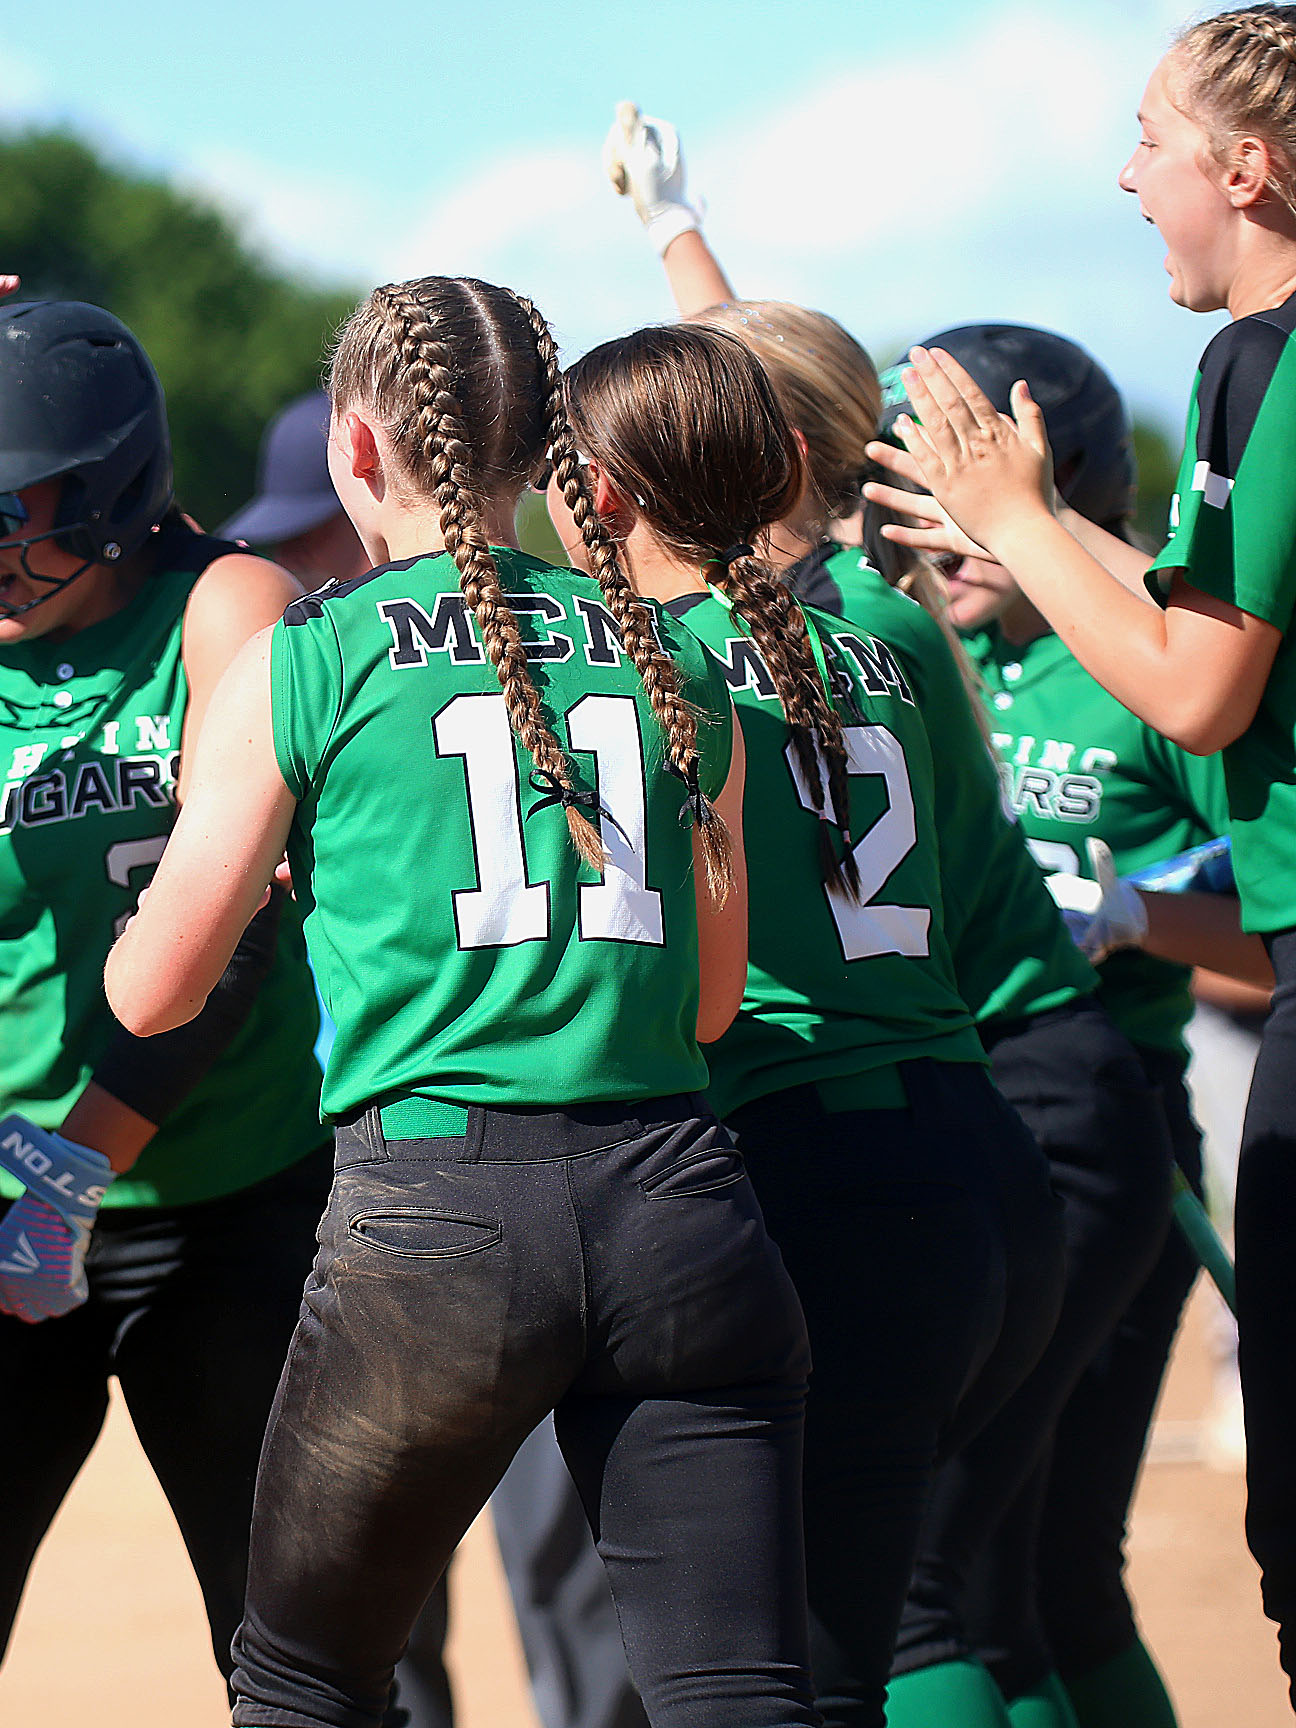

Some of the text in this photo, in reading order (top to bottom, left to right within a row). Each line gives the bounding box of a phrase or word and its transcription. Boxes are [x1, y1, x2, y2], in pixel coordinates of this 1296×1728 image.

[705, 632, 916, 707] MM
[431, 692, 666, 951] 11
[782, 724, 931, 961] 2
